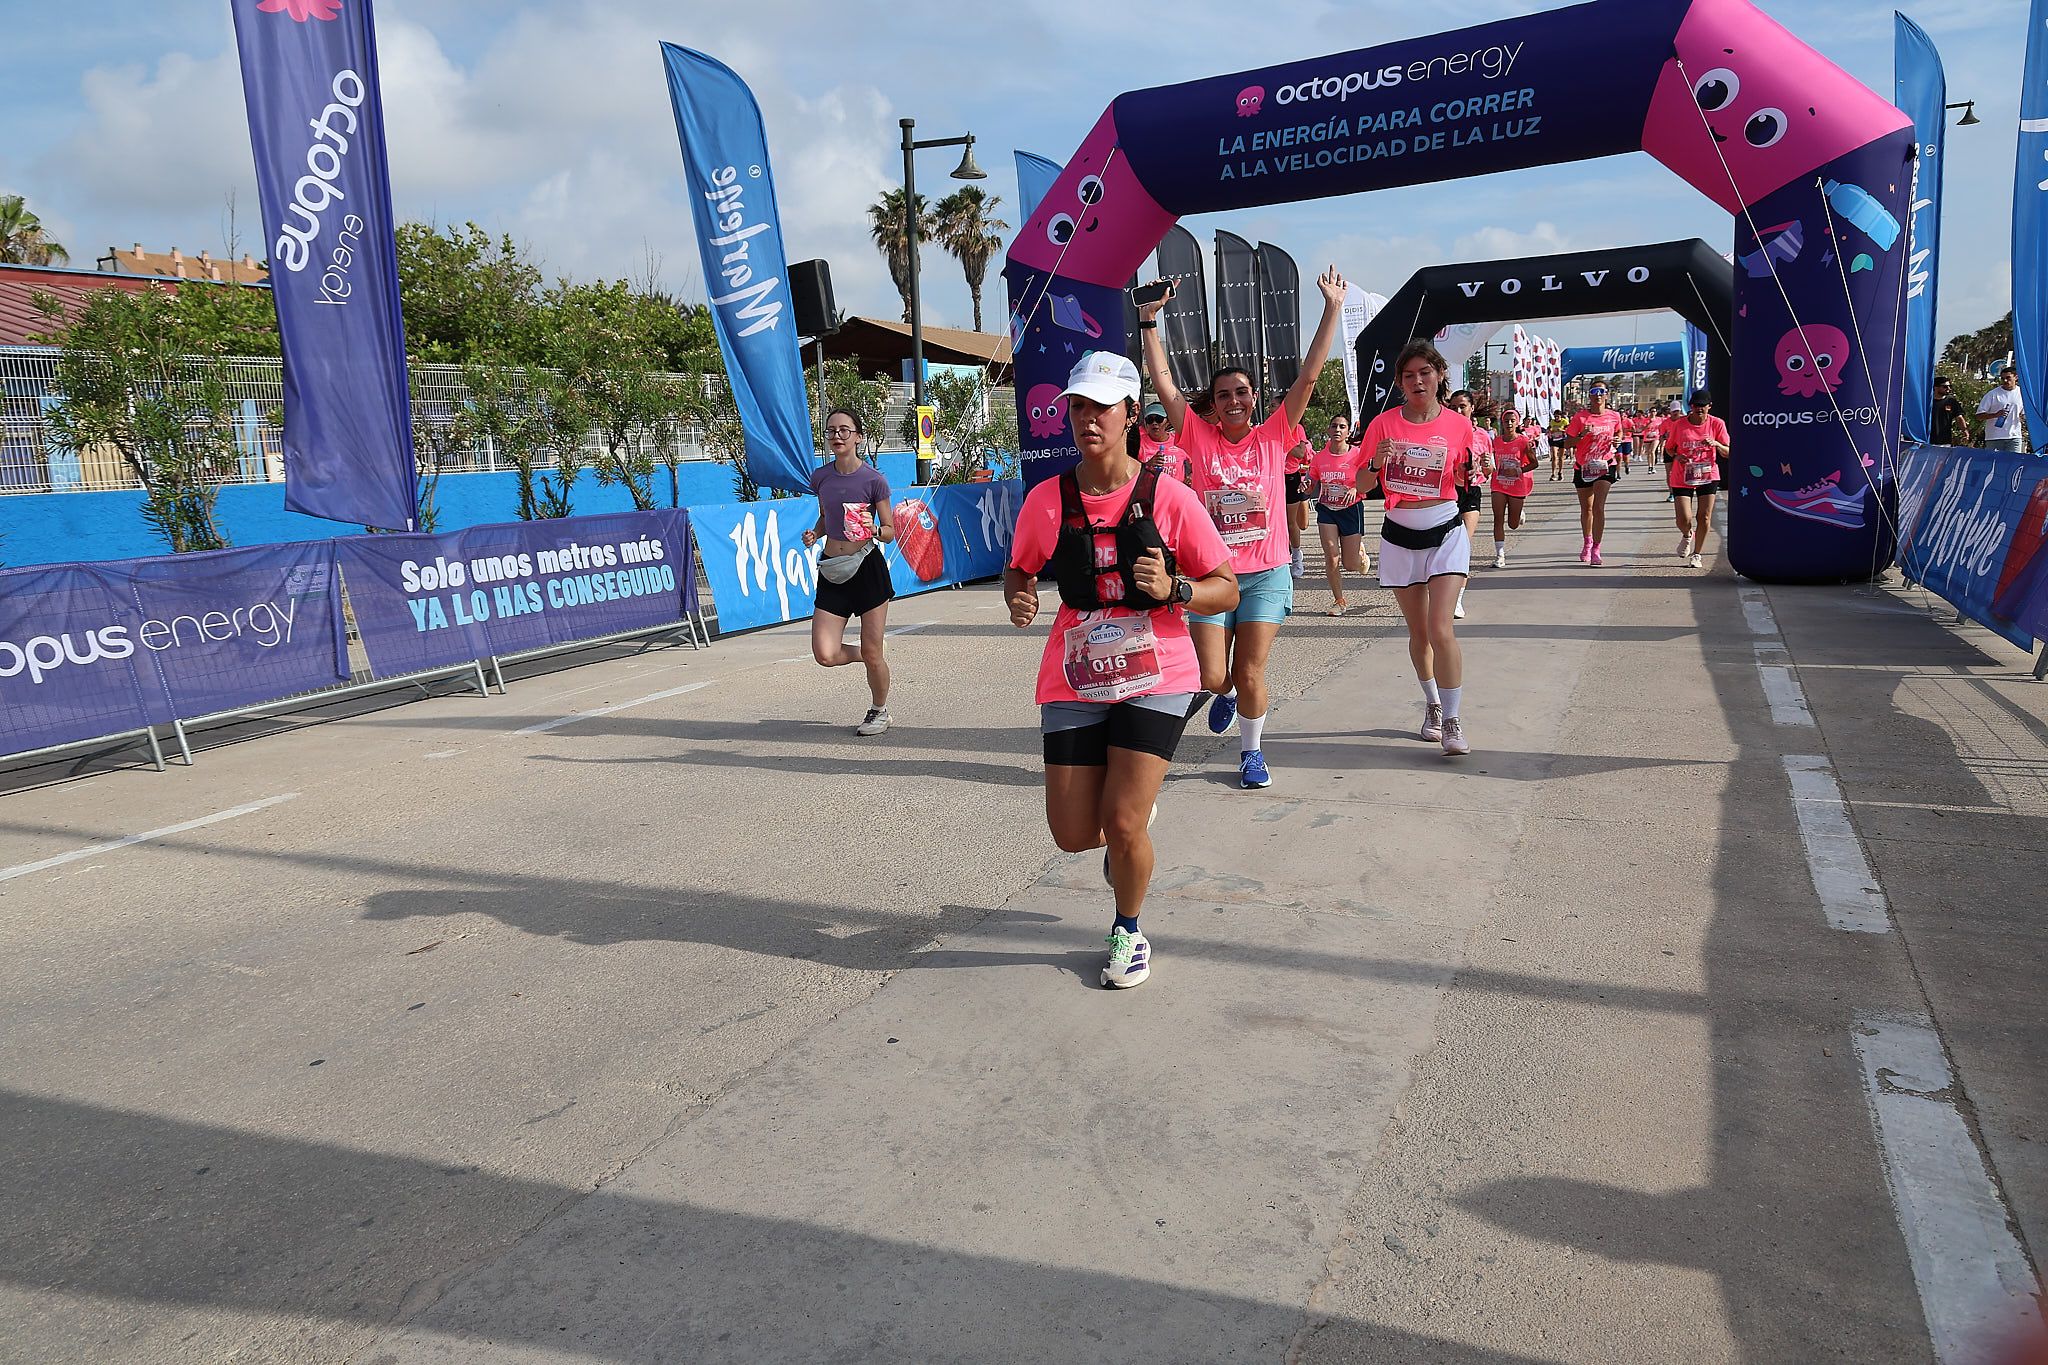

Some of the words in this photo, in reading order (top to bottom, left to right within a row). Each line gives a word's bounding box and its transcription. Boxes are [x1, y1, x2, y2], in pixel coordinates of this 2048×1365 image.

[1275, 65, 1402, 105] octopus
[1407, 41, 1524, 81] energy
[1218, 135, 1246, 156] LA
[1251, 115, 1350, 151] ENERGÍA
[1356, 106, 1423, 135] PARA
[1430, 87, 1536, 124] CORRER
[1220, 164, 1236, 181] A
[1240, 158, 1268, 178] LA
[1274, 138, 1407, 172] VELOCIDAD
[1413, 132, 1445, 153] DE
[1452, 125, 1485, 147] LA
[1491, 116, 1542, 142] LUZ
[1456, 266, 1650, 298] VOLVO
[1601, 347, 1655, 369] Marlene
[1742, 410, 1814, 429] octopus
[1816, 405, 1881, 425] energy
[1404, 466, 1427, 477] 016
[1224, 513, 1248, 524] 016
[400, 556, 466, 593] Solo
[470, 554, 533, 584] unos
[536, 542, 617, 575] metros
[618, 534, 664, 565] más
[407, 595, 449, 632] YA
[451, 589, 490, 626] LO
[492, 581, 544, 619] HAS
[546, 564, 676, 609] CONSEGUIDO
[0, 625, 134, 684] opus
[138, 597, 295, 651] energy
[1092, 654, 1128, 673] 016
